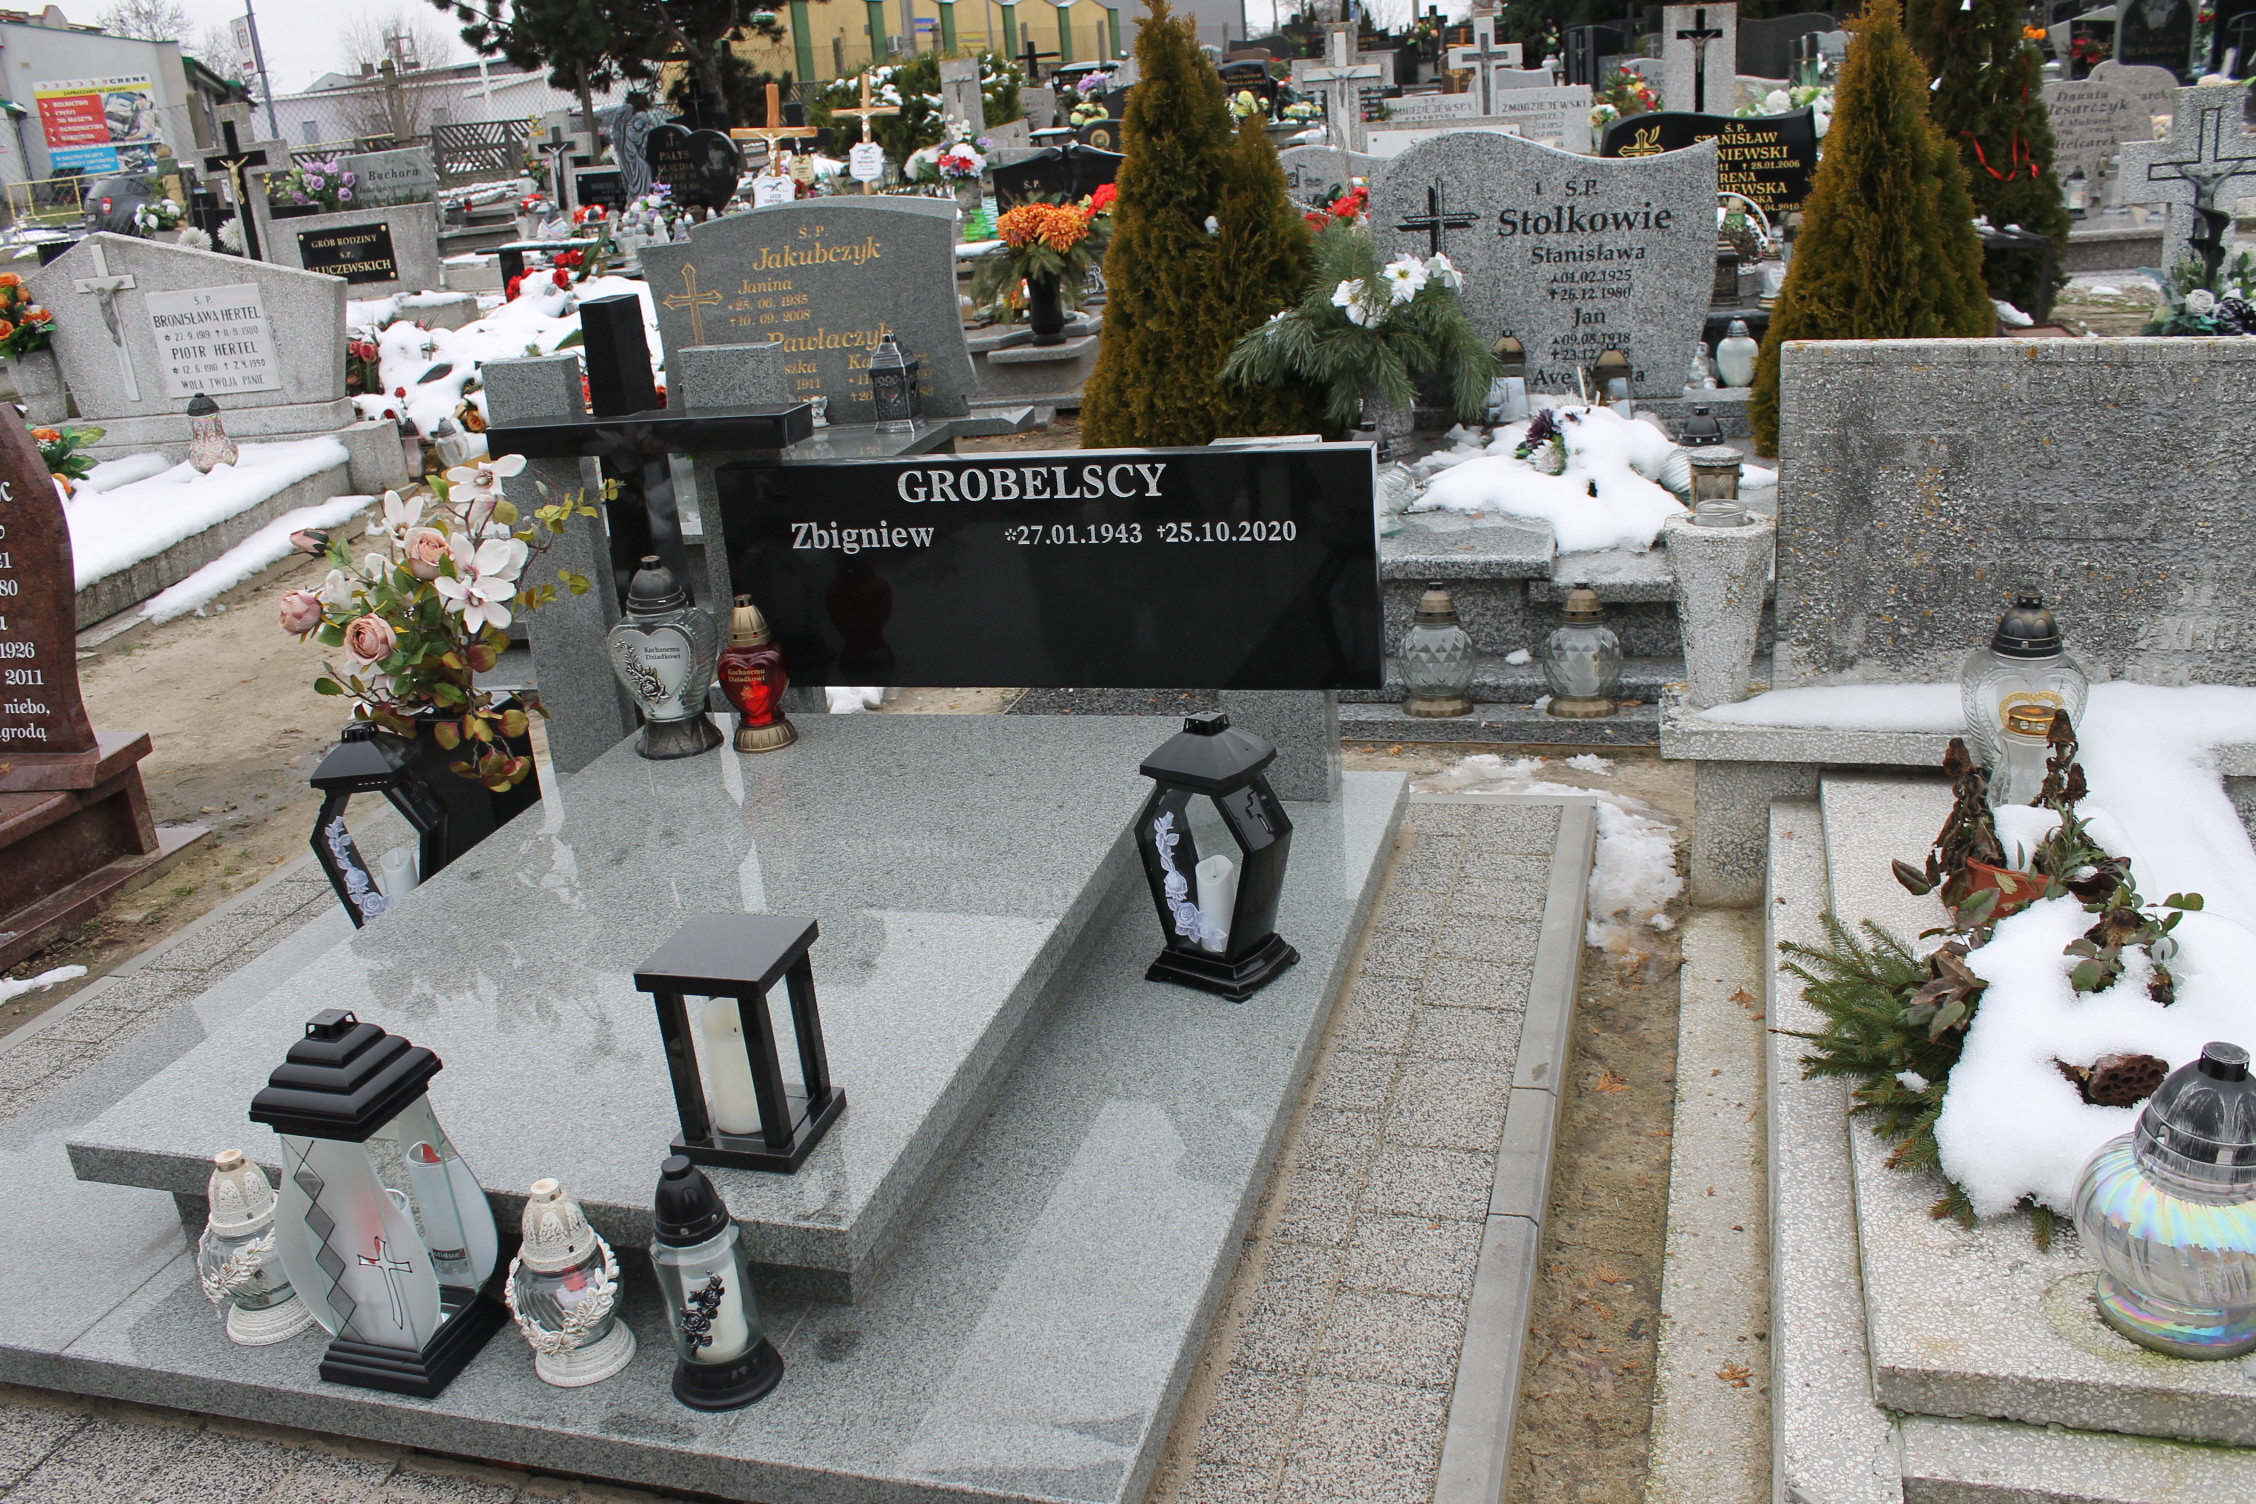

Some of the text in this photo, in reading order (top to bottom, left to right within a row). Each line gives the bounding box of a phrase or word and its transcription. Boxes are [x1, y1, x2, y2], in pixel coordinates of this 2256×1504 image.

[109, 75, 147, 84] GRENE
[1737, 123, 1747, 132] P.
[1751, 160, 1801, 170] 28.01.2006
[1498, 201, 1673, 237] Stołkowie
[815, 225, 828, 237] P.
[311, 233, 378, 249] GRÓB RODZINY
[753, 236, 881, 271] Jakubczyk
[1531, 245, 1647, 265] Stanisława
[1560, 269, 1632, 284] 01.02.1925
[737, 277, 793, 295] Janina
[1560, 287, 1632, 301] 26.12.1980
[153, 306, 261, 328] BRONISŁAWA HERTEL
[783, 309, 811, 322] 2008
[1572, 307, 1606, 328] Jan
[171, 341, 259, 361] PIOTR HERTEL
[1561, 348, 1630, 361] 23.128
[181, 374, 265, 391] WOLA TWOJA PANIE
[1531, 369, 1572, 386] Ave
[897, 462, 1167, 503] GROBELSCY
[791, 520, 1298, 555] Zbigniew 27.01.1943 25.10.2020
[0, 641, 36, 659] 1926
[645, 653, 681, 661] Dziadkowi
[5, 668, 45, 686] 2011
[727, 668, 765, 676] Kochanemu
[728, 674, 765, 683] Dziadkowi
[4, 698, 51, 717] niebo,
